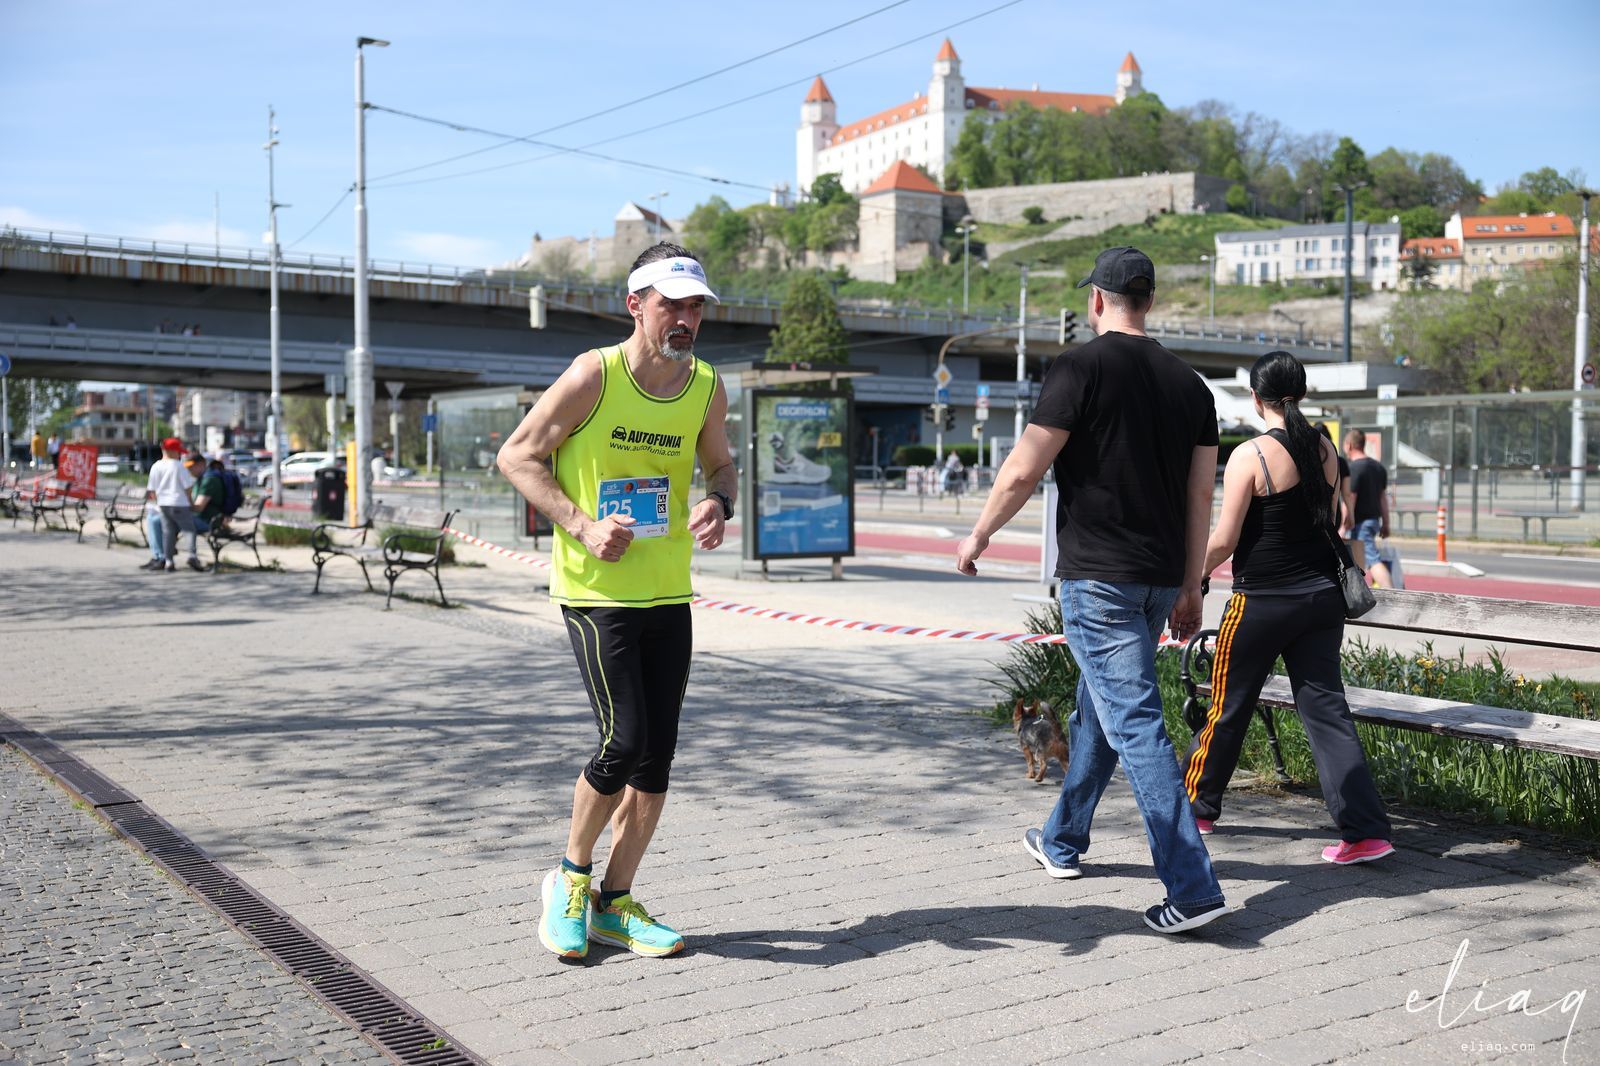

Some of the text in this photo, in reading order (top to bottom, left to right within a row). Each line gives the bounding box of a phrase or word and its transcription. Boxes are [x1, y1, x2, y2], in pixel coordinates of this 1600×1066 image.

[627, 430, 682, 448] AUTOFUNIA
[609, 442, 681, 456] www.autofunia.com
[600, 498, 632, 518] 125
